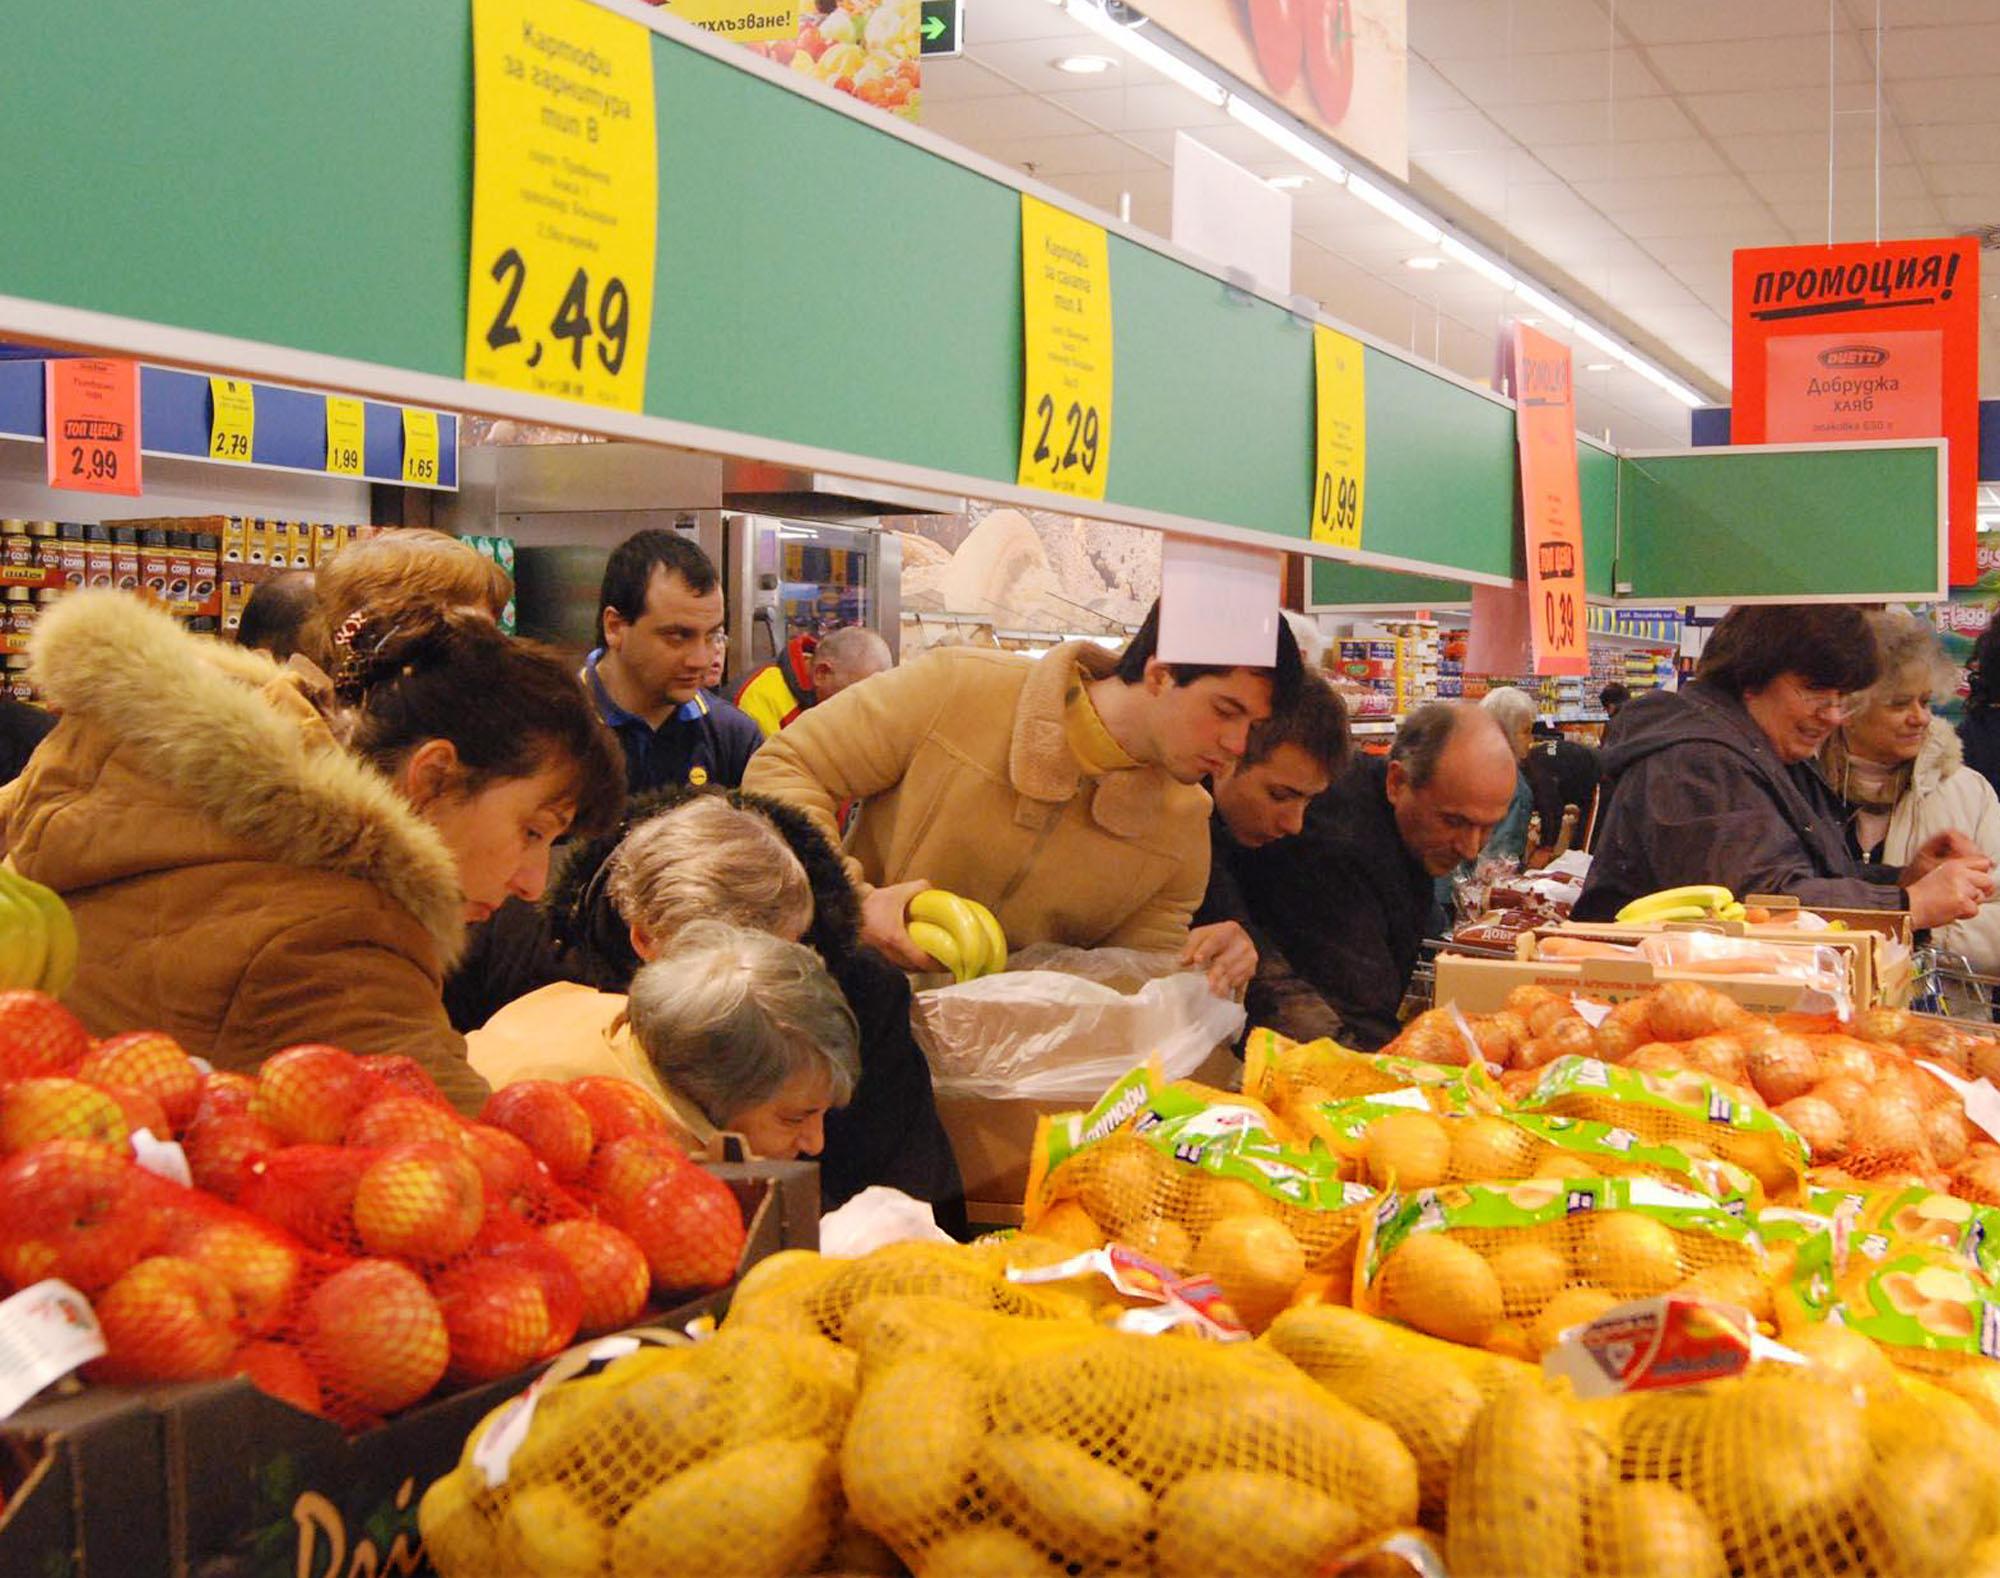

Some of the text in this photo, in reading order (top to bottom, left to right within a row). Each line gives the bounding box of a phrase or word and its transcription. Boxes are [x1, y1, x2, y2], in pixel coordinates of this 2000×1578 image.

[522, 18, 612, 79] Картофи
[1753, 252, 1961, 304] ПРОМОЦИЯ!
[486, 247, 630, 376] 2,49
[1807, 375, 1899, 397] Добруджа
[1833, 396, 1874, 413] хляб
[215, 432, 248, 456] 2,79
[1033, 393, 1100, 475] 2,29
[71, 446, 117, 480] 2,99
[333, 447, 359, 470] 1,99
[408, 458, 433, 478] 1,65
[1321, 472, 1357, 531] 0,99
[1545, 590, 1574, 652] 0,39
